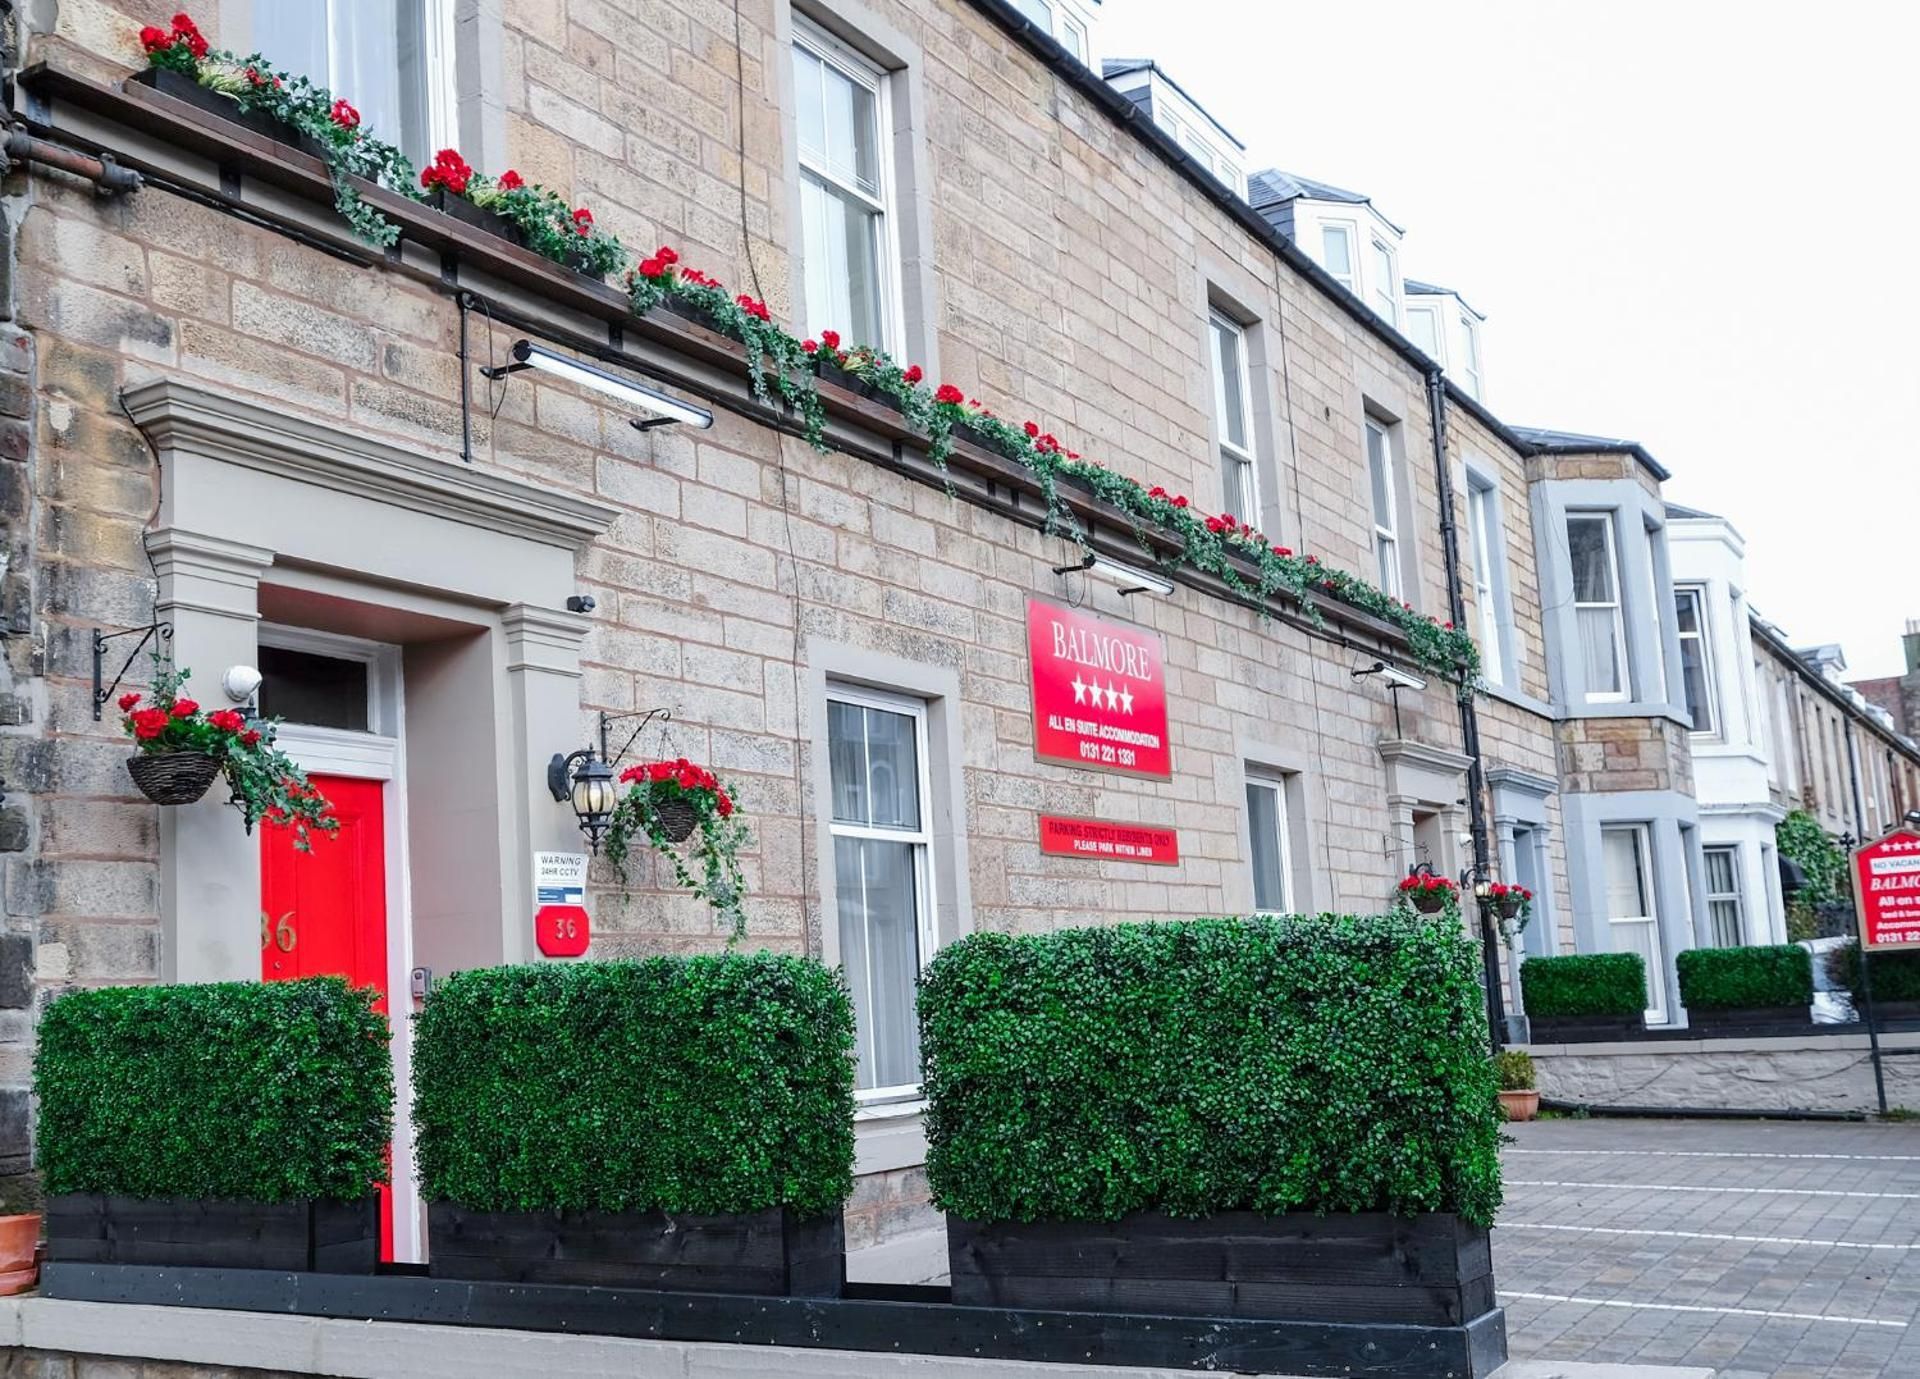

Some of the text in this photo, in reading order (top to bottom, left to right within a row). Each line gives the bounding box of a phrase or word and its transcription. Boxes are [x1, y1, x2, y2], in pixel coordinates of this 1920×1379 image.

[1051, 621, 1152, 682] BALMORE
[1048, 714, 1160, 749] ALL EN SUITE ACCOMMODATION
[1079, 741, 1136, 766] 0131 221 1331
[1048, 821, 1082, 836] PARKING
[1083, 824, 1116, 841] STRICTLY
[1073, 839, 1098, 852] PLEASE
[1098, 842, 1114, 854] PARK
[541, 855, 581, 866] WARNING
[541, 866, 579, 876] 24HR CCTV
[555, 918, 577, 940] 36
[1876, 932, 1903, 943] 0131
